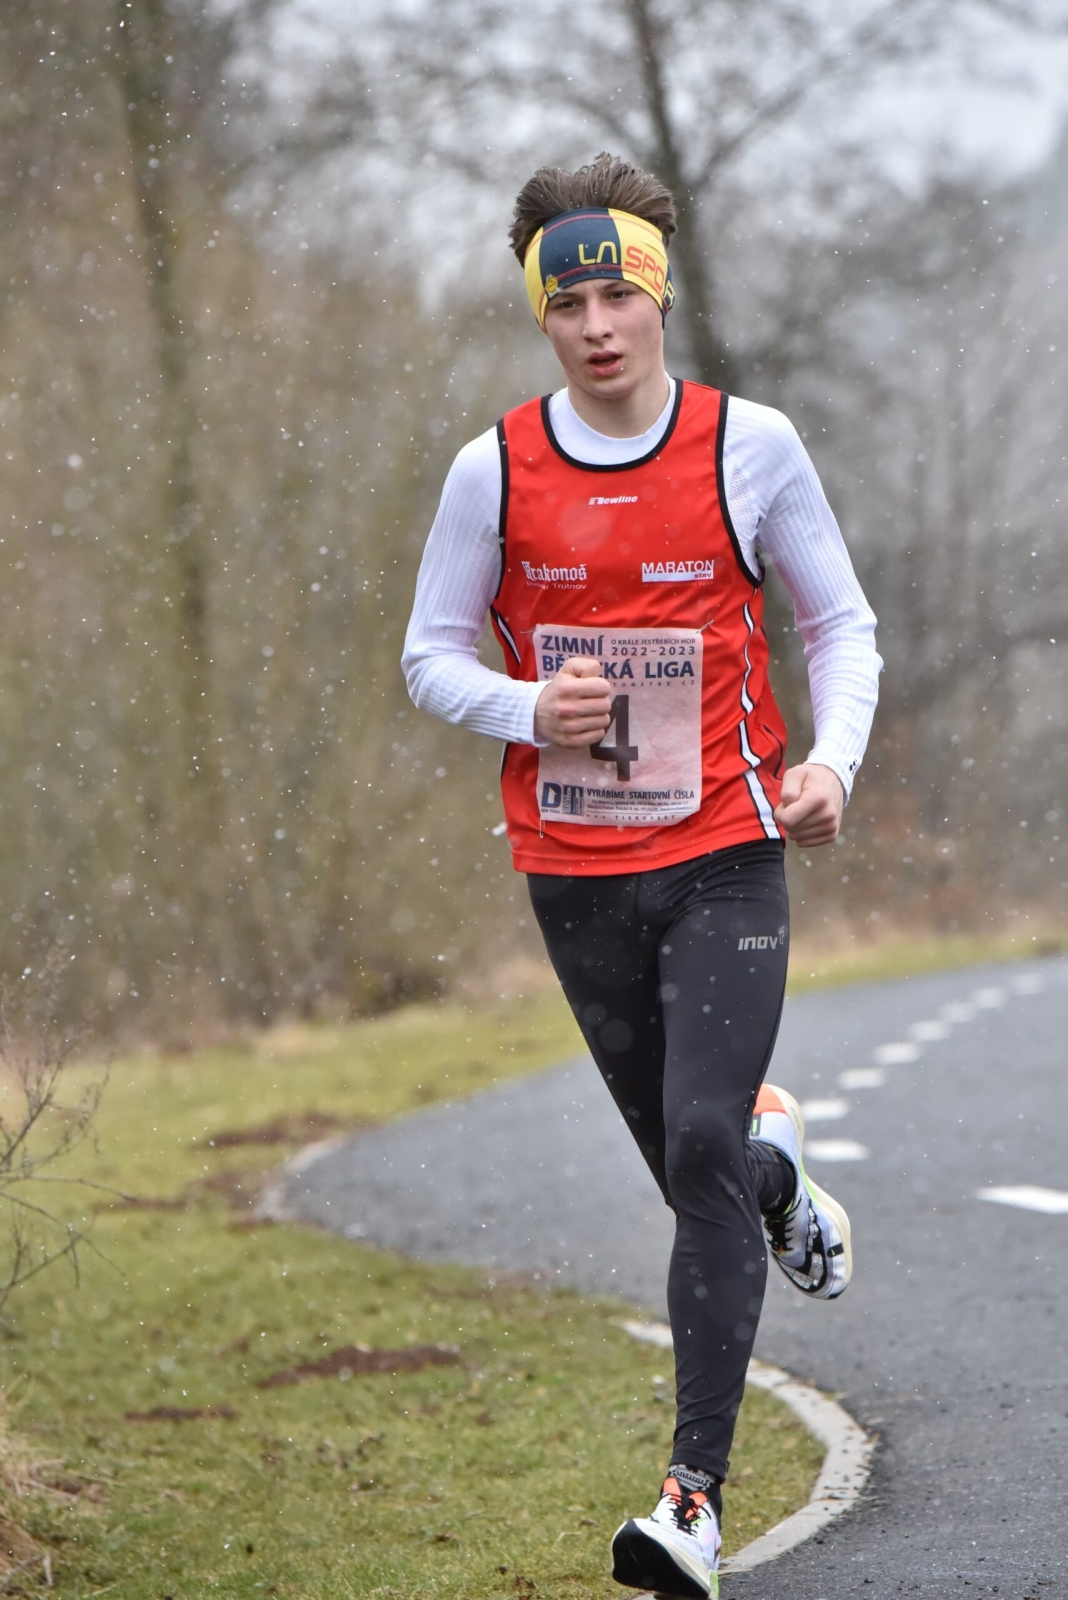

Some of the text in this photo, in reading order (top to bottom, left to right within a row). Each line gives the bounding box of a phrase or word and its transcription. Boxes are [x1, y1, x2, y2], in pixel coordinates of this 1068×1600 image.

[578, 241, 618, 265] LA
[642, 560, 714, 575] MARATON
[552, 582, 587, 590] Trutnov
[541, 635, 605, 656] ZIMNÍ
[542, 653, 695, 679] BĚKÁ LIGA
[589, 694, 639, 782] 4
[586, 787, 695, 800] VYRÁBÍME STARTOVNÍ ČÍSLA
